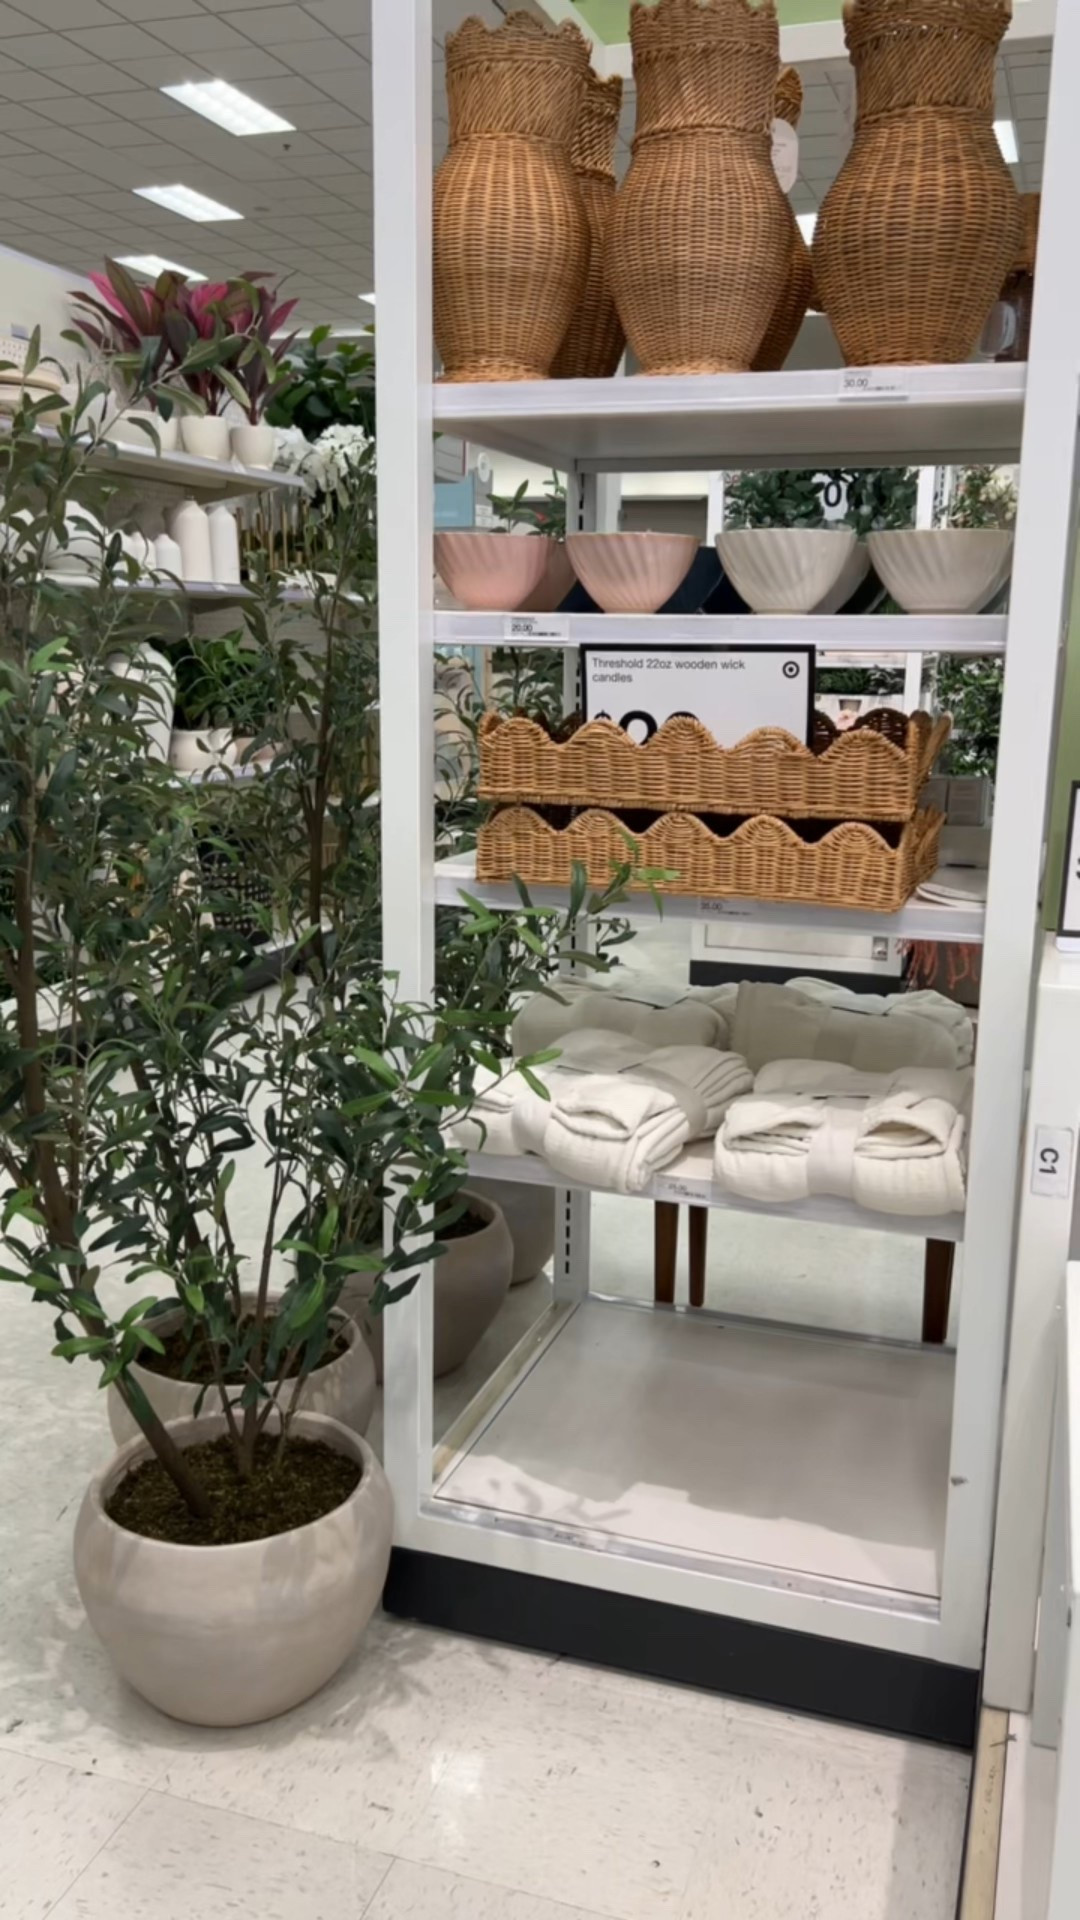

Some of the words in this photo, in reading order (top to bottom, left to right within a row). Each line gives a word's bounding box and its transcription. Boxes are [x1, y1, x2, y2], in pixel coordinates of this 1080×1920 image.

[592, 657, 644, 669] Threshold
[646, 658, 672, 669] 22oz
[674, 659, 718, 670] wooden
[720, 660, 745, 670] wick
[592, 672, 633, 683] candles
[1039, 1147, 1059, 1174] C1
